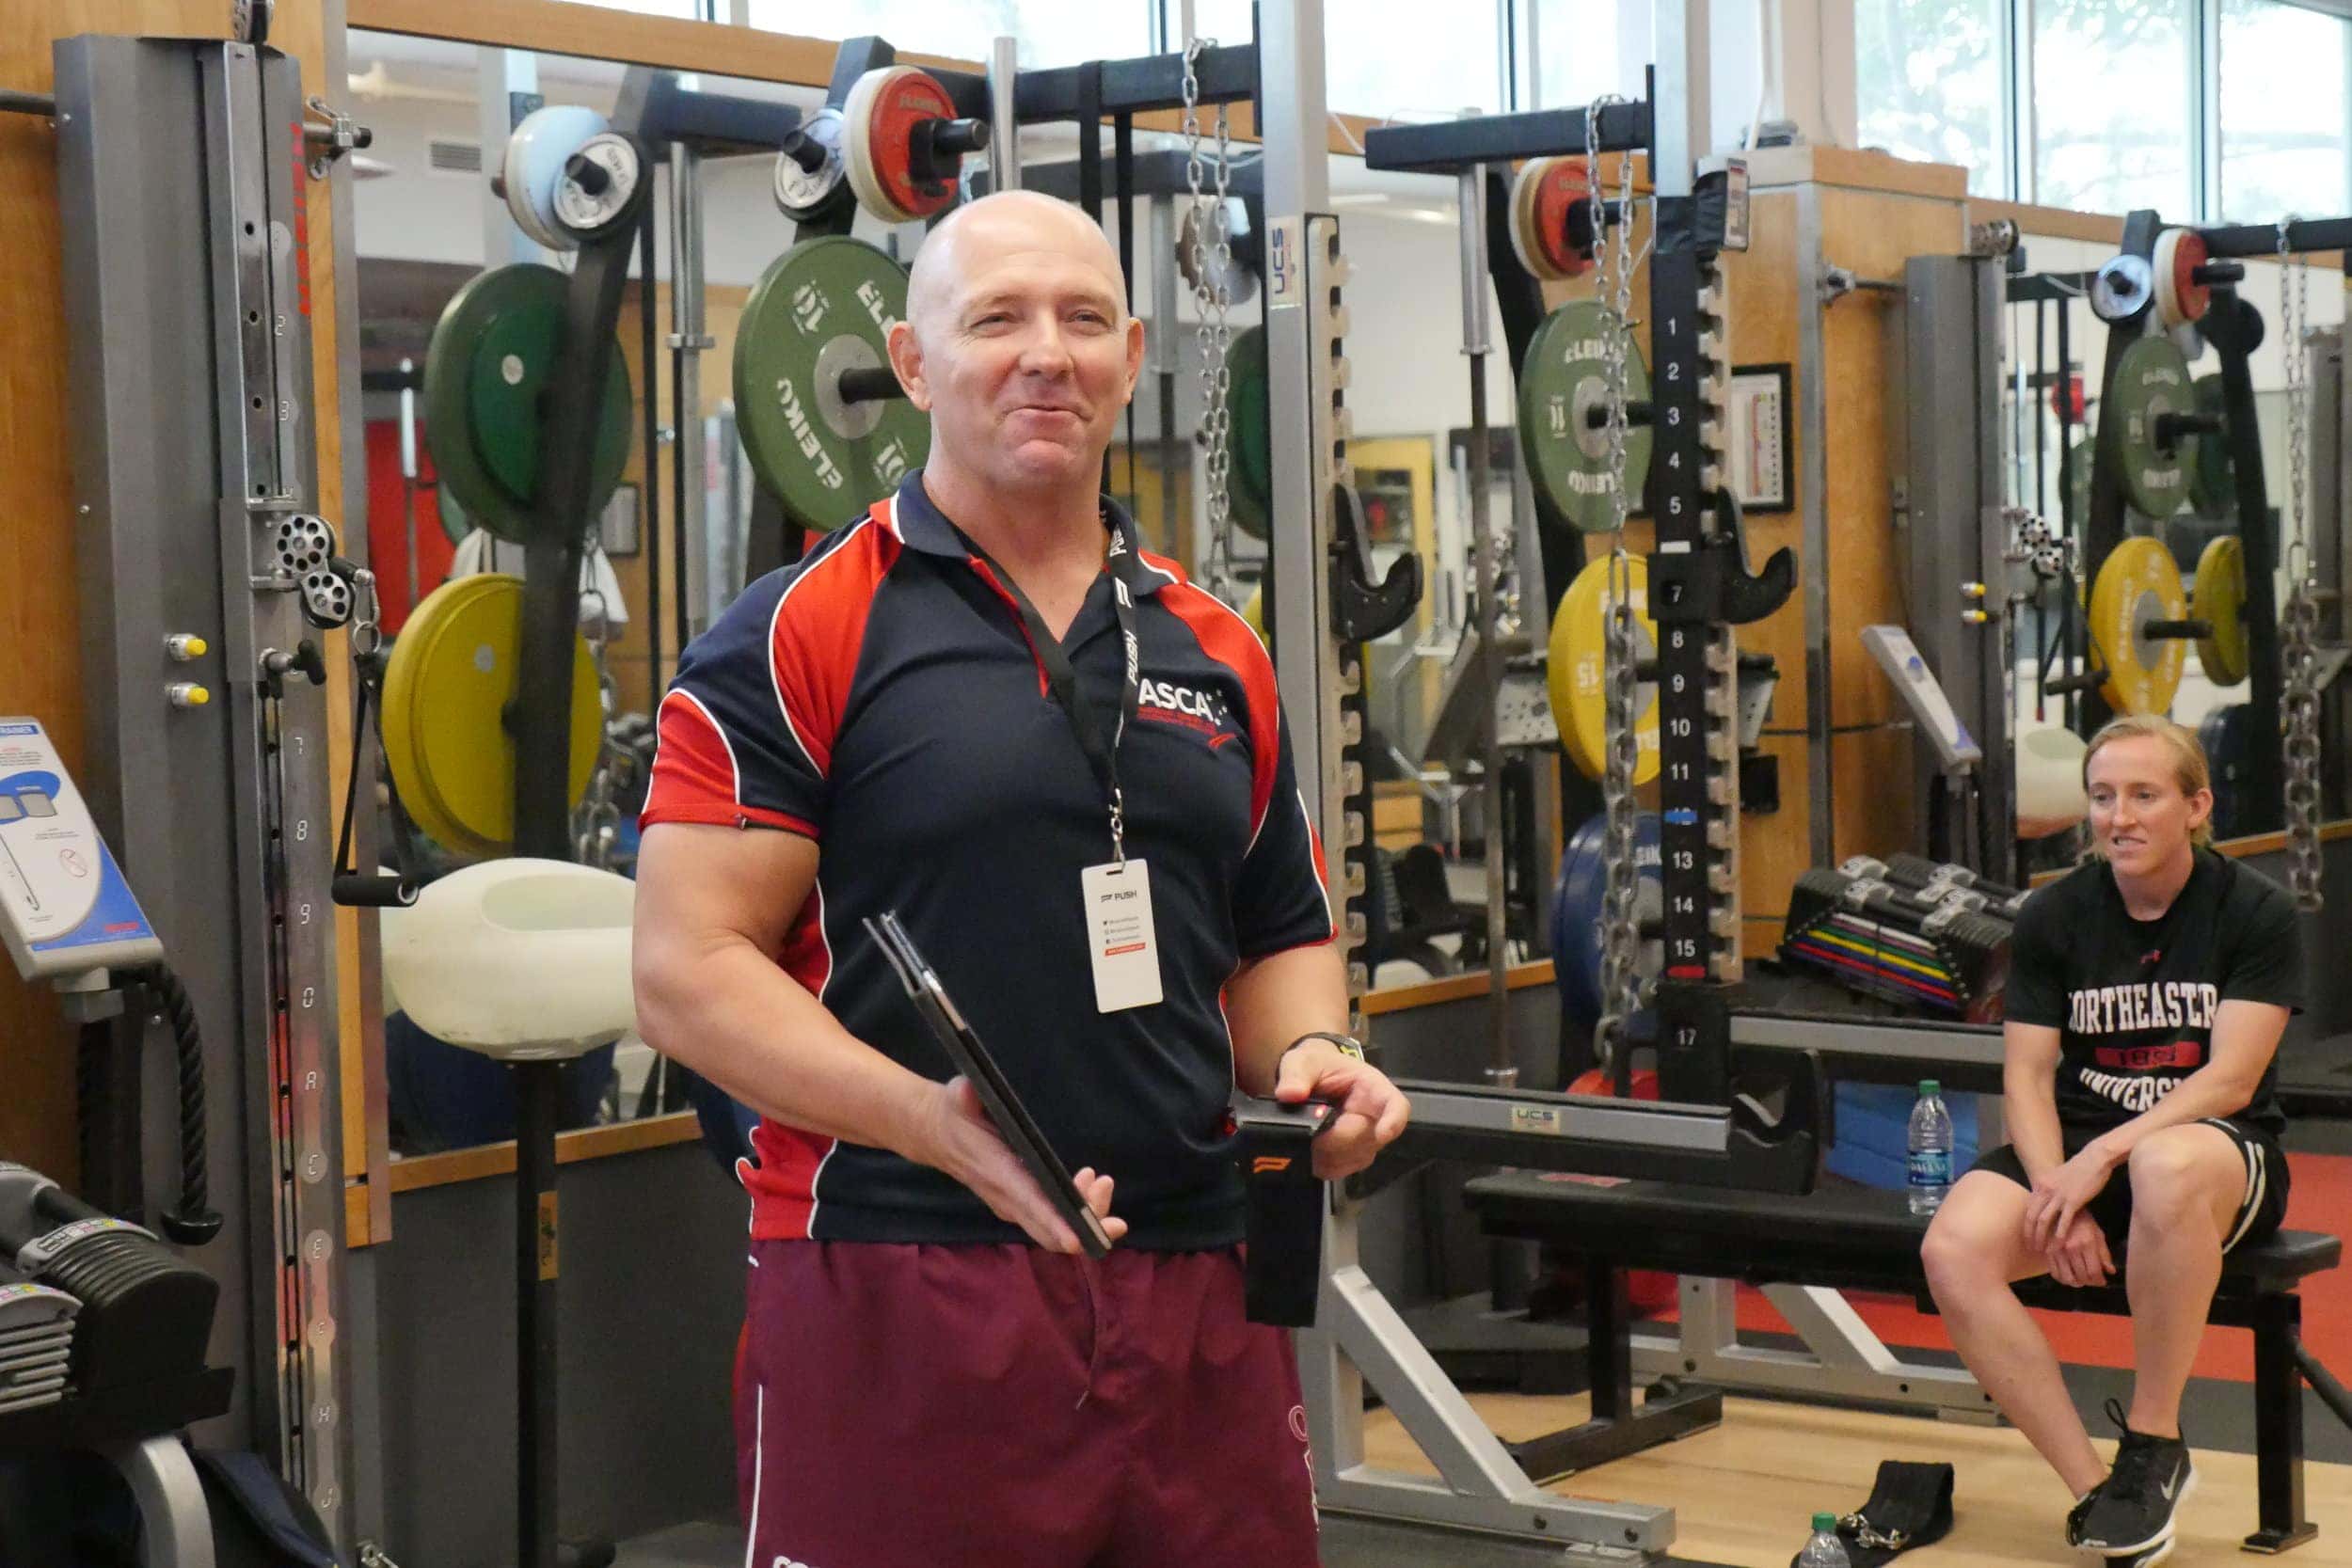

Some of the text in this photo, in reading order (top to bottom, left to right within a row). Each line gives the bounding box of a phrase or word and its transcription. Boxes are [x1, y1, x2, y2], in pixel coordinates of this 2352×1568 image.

[1272, 228, 1285, 293] UCS
[1668, 317, 1677, 336] 1
[1667, 362, 1679, 380] 2
[279, 400, 289, 421] 3
[1667, 406, 1680, 425] 3
[1668, 451, 1680, 468] 4
[1670, 497, 1682, 515] 5
[1671, 585, 1682, 603] 7
[1672, 630, 1684, 648] 8
[1125, 629, 1138, 687] PUSH
[1673, 674, 1685, 692] 9
[1137, 677, 1216, 722] ASCA
[1670, 719, 1692, 736] 10
[1671, 763, 1690, 780] 11
[296, 819, 308, 840] 8
[1672, 850, 1693, 869] 13
[1114, 890, 1137, 901] PUSH
[1674, 896, 1694, 913] 14
[300, 904, 311, 925] 9
[1676, 940, 1696, 958] 15
[1677, 1028, 1697, 1046] 17
[305, 1070, 316, 1091] A
